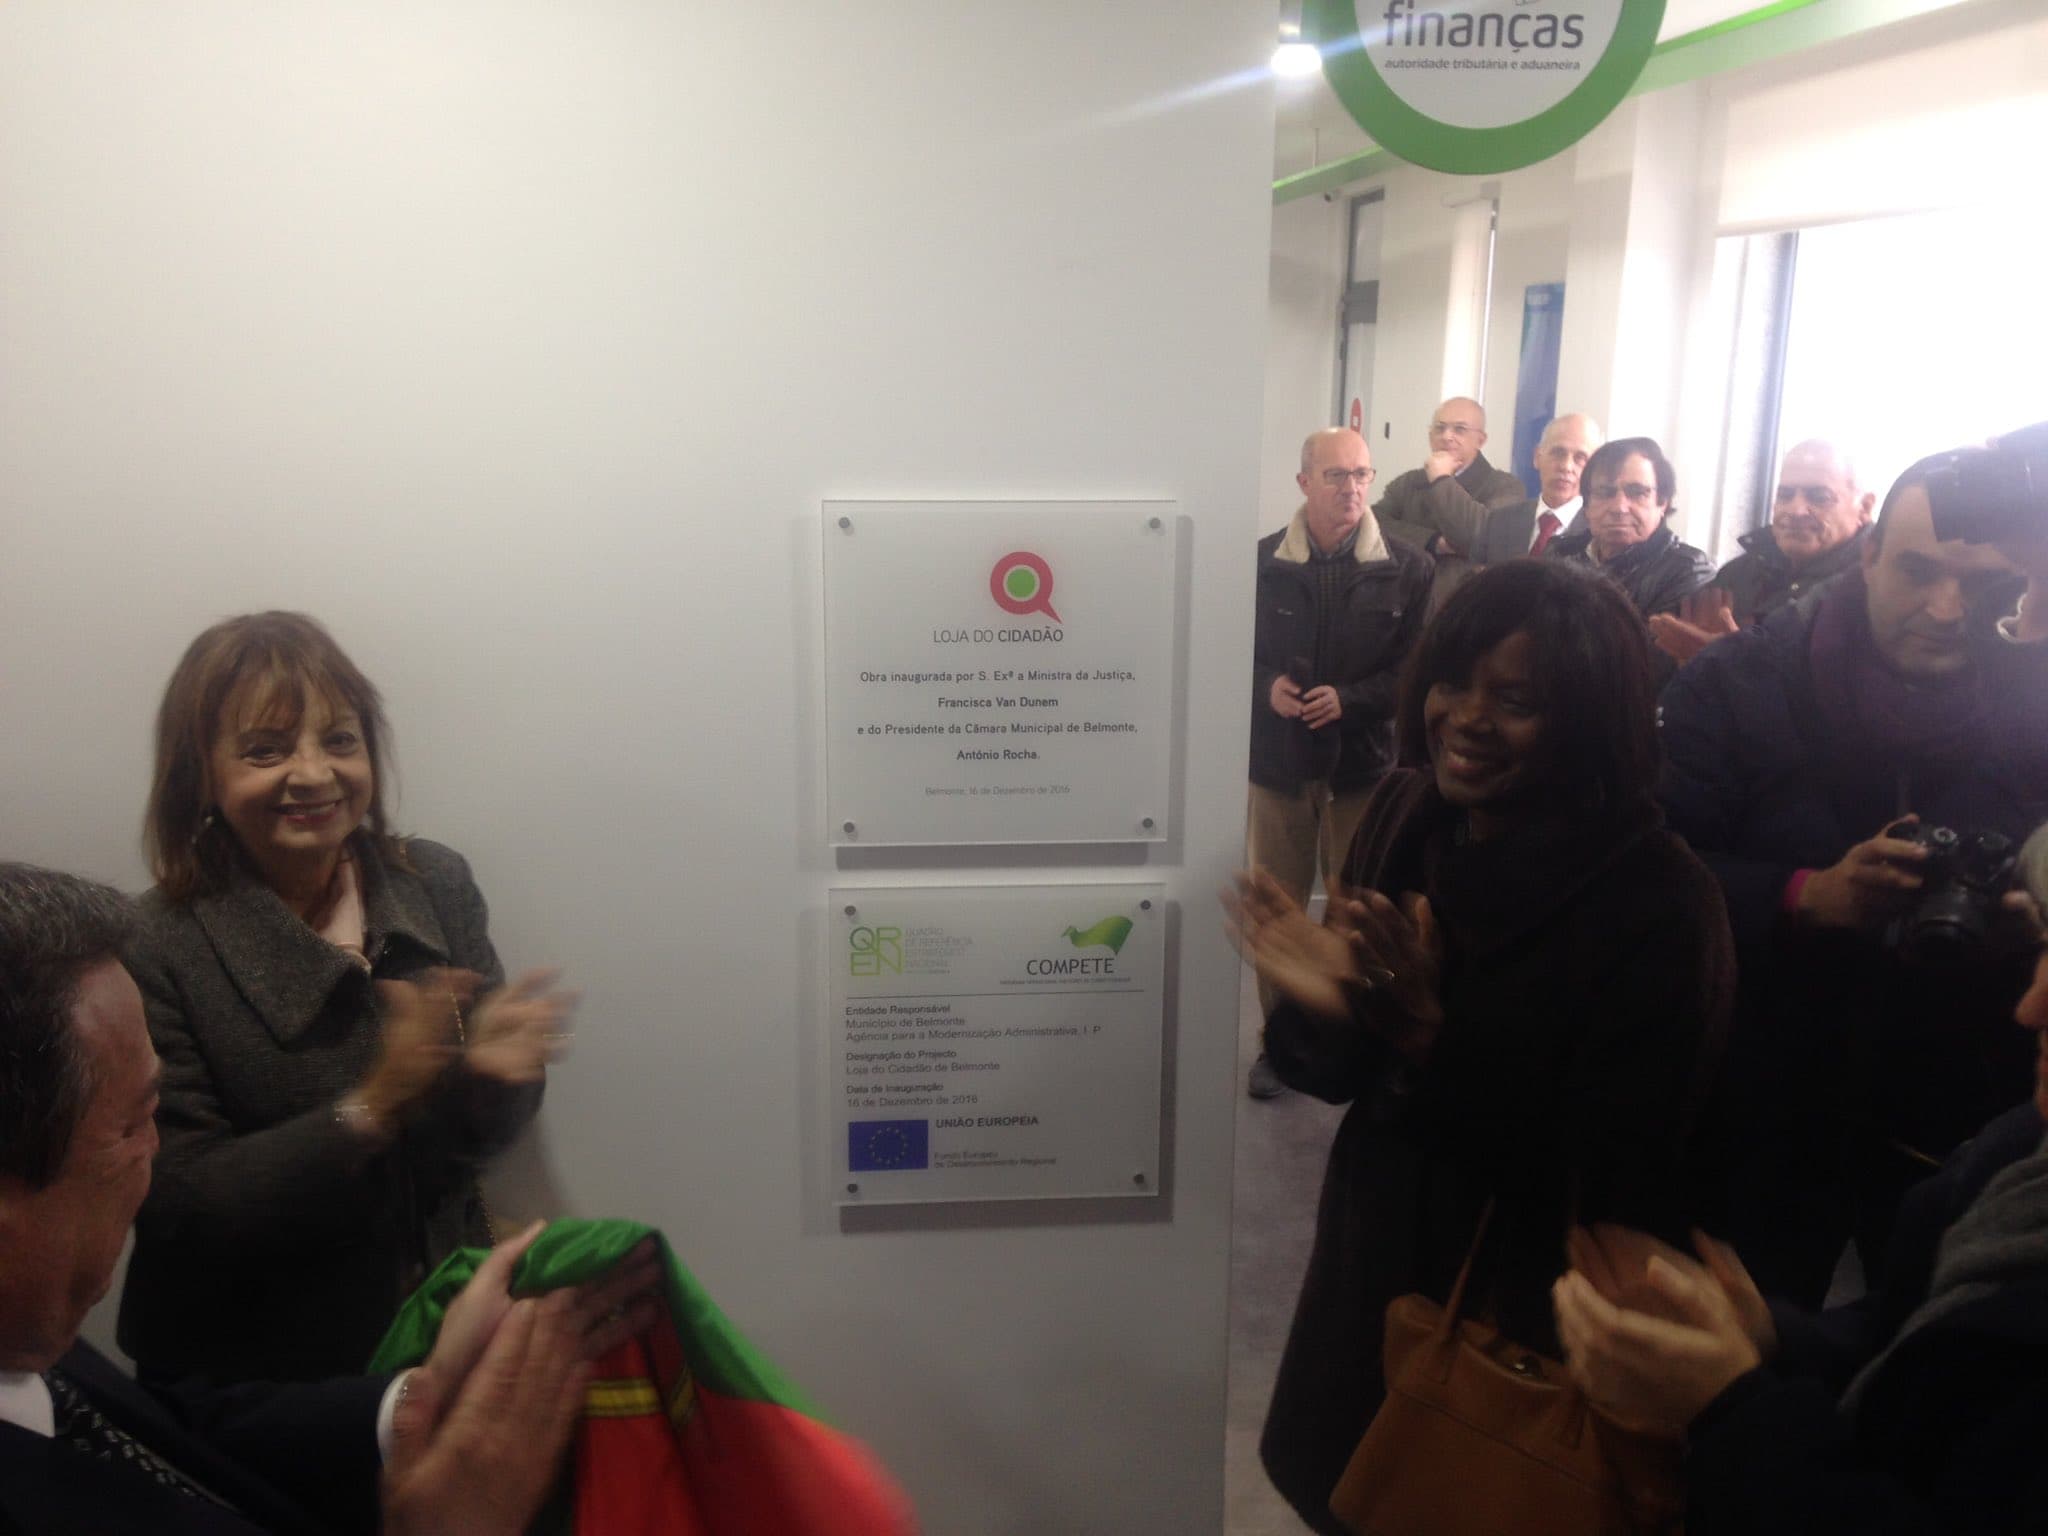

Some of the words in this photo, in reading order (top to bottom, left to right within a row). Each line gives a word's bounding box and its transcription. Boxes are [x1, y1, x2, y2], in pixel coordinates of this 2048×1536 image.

[1383, 0, 1584, 52] finanças
[1384, 58, 1450, 70] autoridade
[1453, 58, 1508, 70] tributária
[1510, 61, 1519, 70] e
[1520, 59, 1581, 71] aduaneira
[933, 629, 969, 644] LOJA
[974, 629, 994, 643] DO
[997, 626, 1064, 643] CIDADÃO
[860, 671, 887, 682] Obra
[890, 671, 953, 684] inaugurada
[956, 672, 975, 684] por
[979, 671, 990, 682] S.
[1017, 673, 1025, 682] a
[1027, 670, 1072, 682] Ministra
[1075, 670, 1089, 681] da
[1092, 670, 1136, 684] Justiça,
[938, 697, 993, 709] Francisca
[996, 697, 1016, 708] Van
[1019, 697, 1059, 708] Dunem
[857, 727, 865, 735] e
[868, 724, 882, 735] do
[885, 724, 945, 735] Presidente
[948, 724, 962, 734] da
[965, 722, 1007, 734] Câmara
[1010, 722, 1063, 736] Municipal
[1067, 722, 1080, 733] de
[1083, 722, 1138, 734] Belmonte,
[956, 748, 1000, 760] António
[1003, 748, 1040, 760] Rocha.
[980, 786, 991, 796] de
[993, 785, 1034, 796] Dezembro
[1037, 785, 1048, 795] de
[1026, 957, 1115, 976] COMPETE
[845, 1007, 887, 1016] Entidade
[889, 1004, 951, 1016] Responsável
[845, 1018, 896, 1029] Município
[899, 1018, 913, 1027] de
[916, 1016, 965, 1027] Belmonte
[846, 1031, 889, 1043] Agência
[891, 1031, 915, 1042] para
[846, 1051, 902, 1063] Designação
[904, 1050, 916, 1060] do
[918, 1049, 957, 1061] Projecto
[872, 1063, 885, 1074] do
[887, 1062, 932, 1074] Cidadão
[935, 1062, 948, 1073] de
[951, 1061, 1001, 1072] Belmonte
[846, 1084, 869, 1095] Data
[871, 1083, 883, 1094] de
[862, 1097, 875, 1107] de
[879, 1095, 933, 1107] Dezembro
[936, 1095, 949, 1105] de
[936, 1116, 975, 1129] UNIÃO
[977, 1115, 1039, 1128] EUROPEIA
